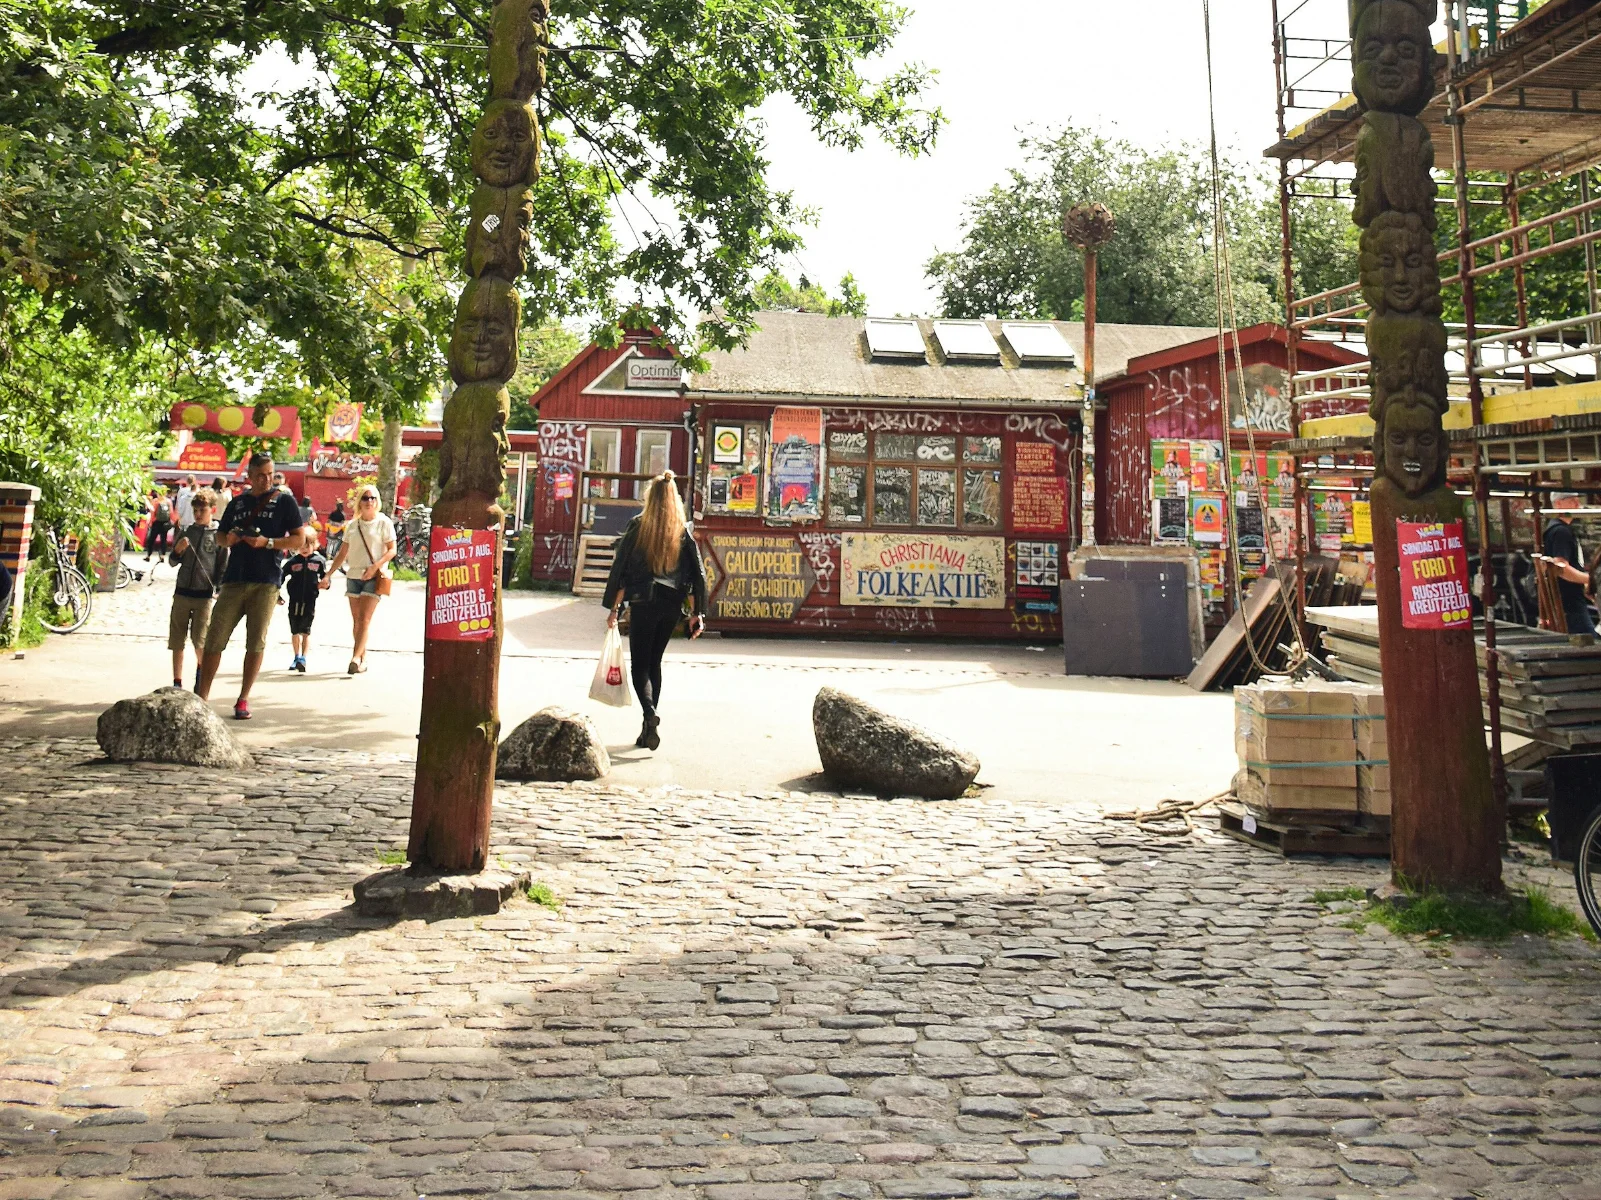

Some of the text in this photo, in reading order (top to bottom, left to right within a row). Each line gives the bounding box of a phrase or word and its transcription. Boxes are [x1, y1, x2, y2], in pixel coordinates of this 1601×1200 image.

[630, 363, 682, 378] Optimist
[739, 536, 763, 548] MUSEUM
[764, 536, 775, 549] FOR
[1401, 540, 1432, 555] SØNDAG
[432, 548, 458, 564] SØNDAG
[475, 544, 493, 557] AUG.
[879, 542, 966, 572] CHRISTIANIA
[437, 563, 481, 588] FORD T
[1412, 555, 1456, 580] FORD T
[726, 578, 748, 597] ART
[856, 570, 988, 599] FOLKEAKTIE
[1411, 581, 1455, 600] RUGSTED
[434, 589, 477, 610] RUGSTED
[1408, 593, 1471, 616] KREUTZFELDT
[431, 601, 493, 625] KREUTZFELDT
